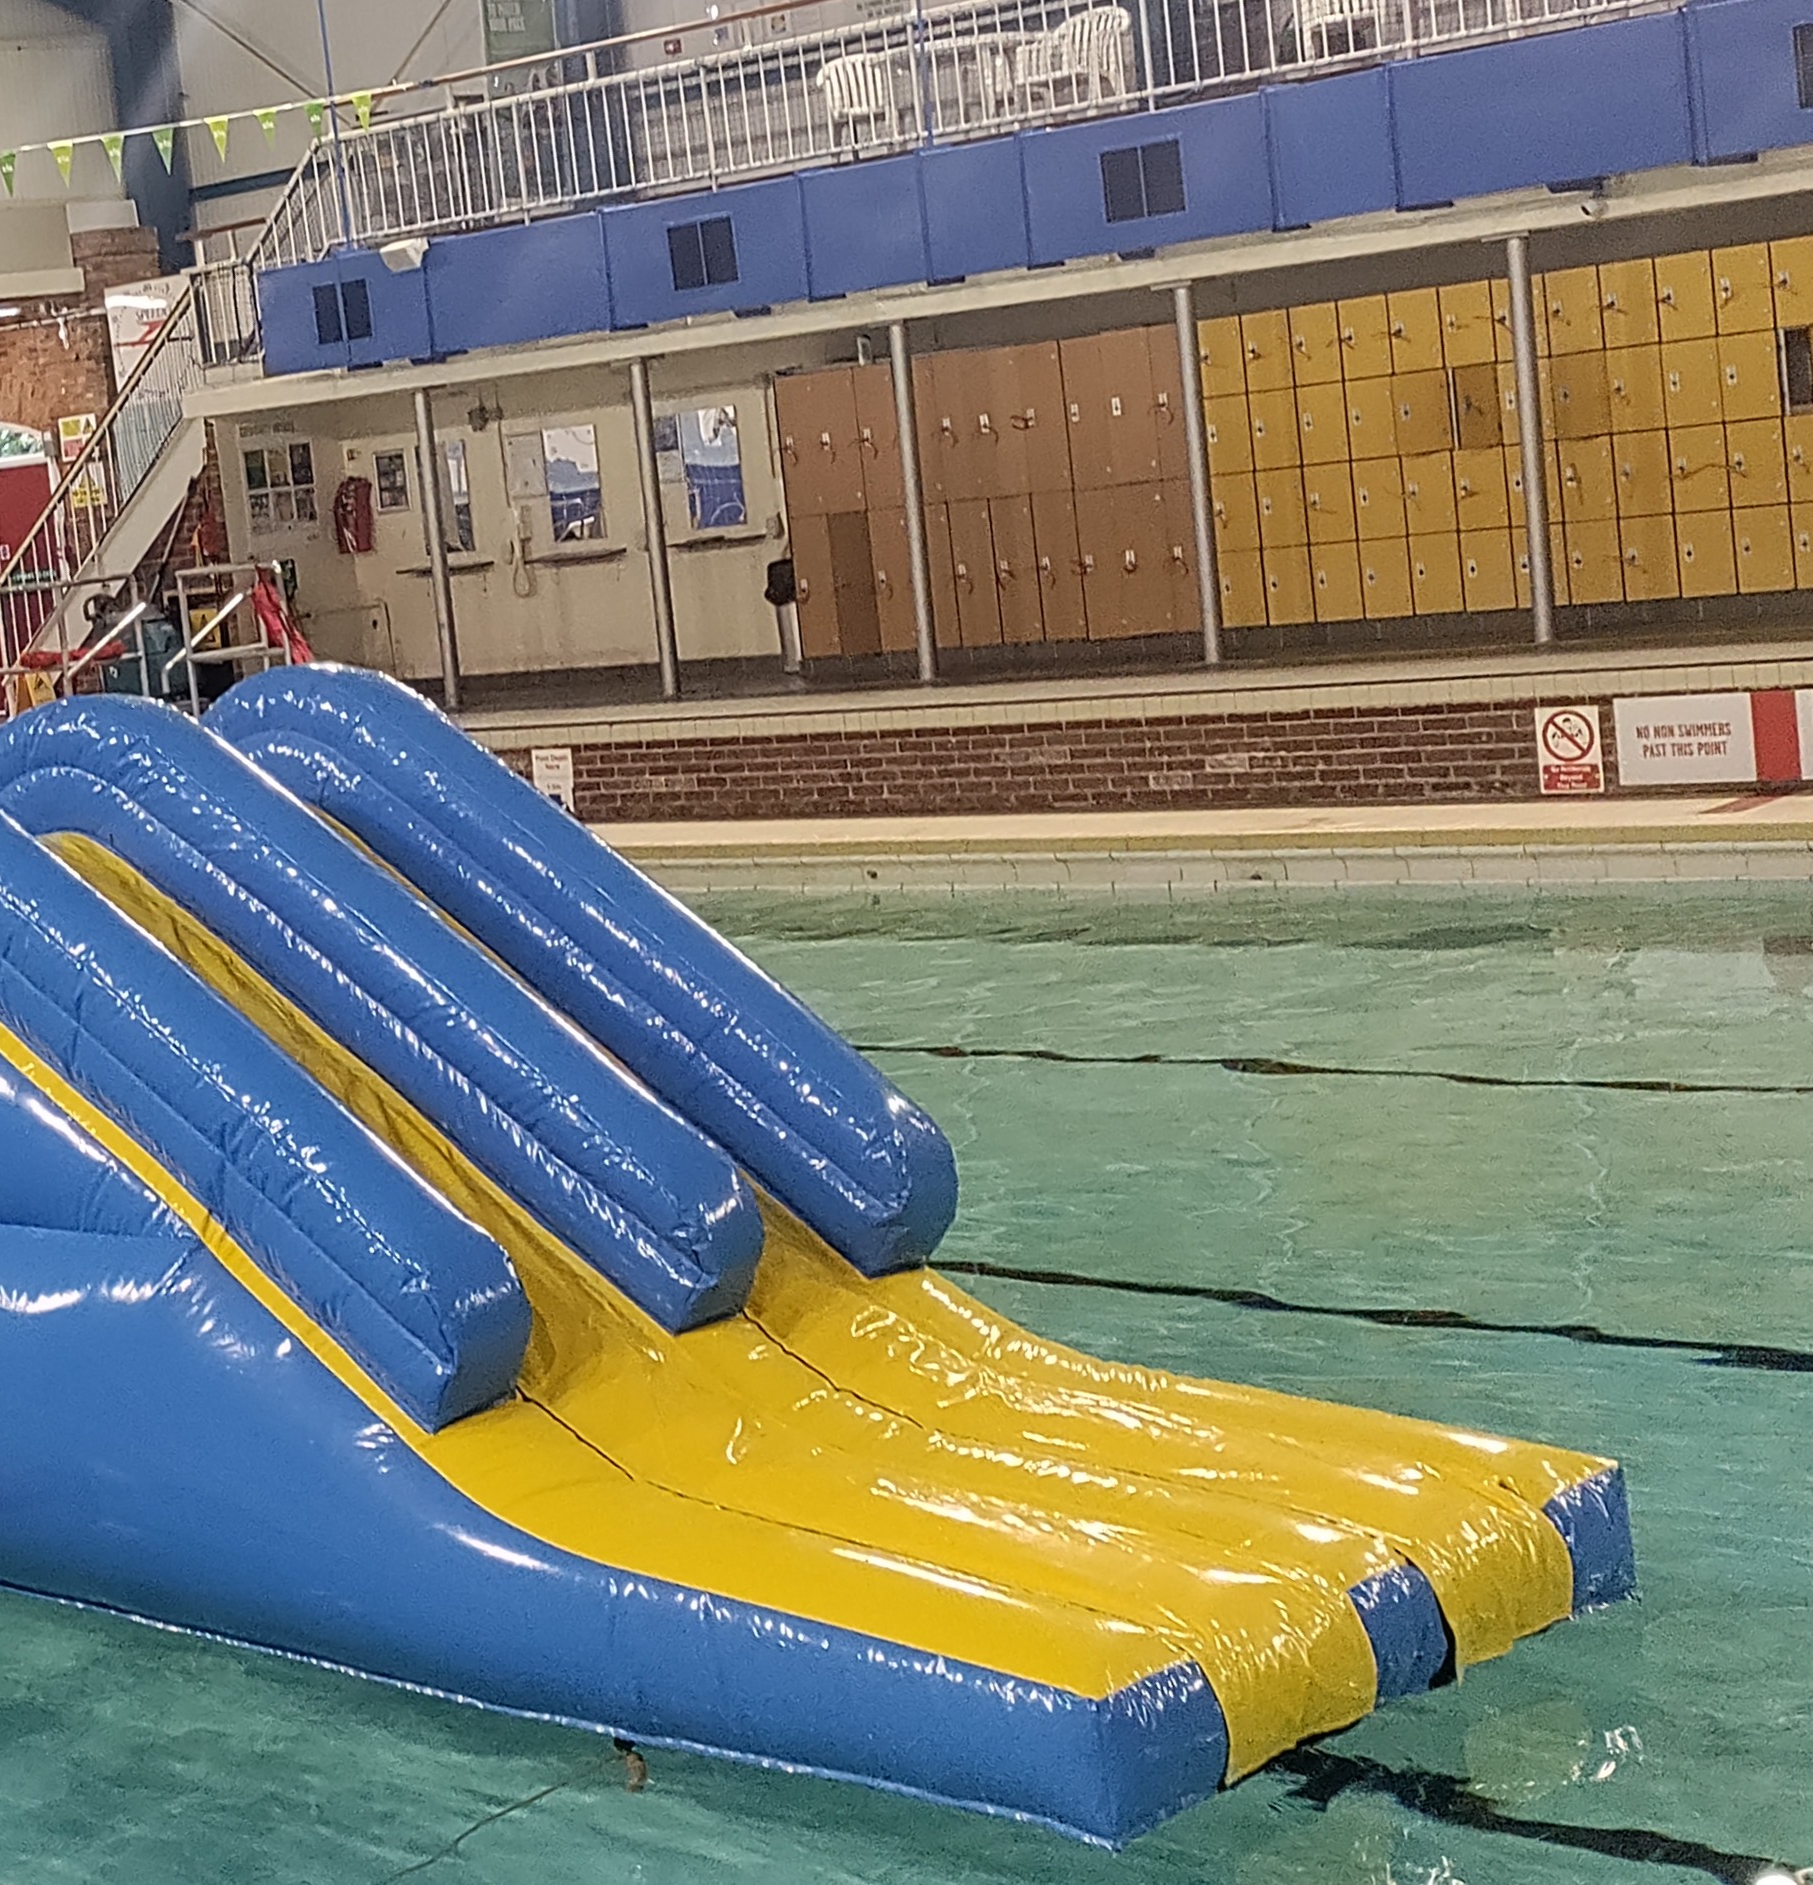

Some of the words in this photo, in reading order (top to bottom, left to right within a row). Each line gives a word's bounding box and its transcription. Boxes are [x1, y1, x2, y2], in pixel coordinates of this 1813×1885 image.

[136, 307, 169, 321] SPEED
[1636, 724, 1650, 740] NO
[1653, 724, 1675, 740] NON
[1677, 721, 1732, 739] SWIMMERS
[1642, 743, 1667, 759] PAST
[1670, 742, 1694, 757] THIS
[1696, 740, 1728, 757] POINT
